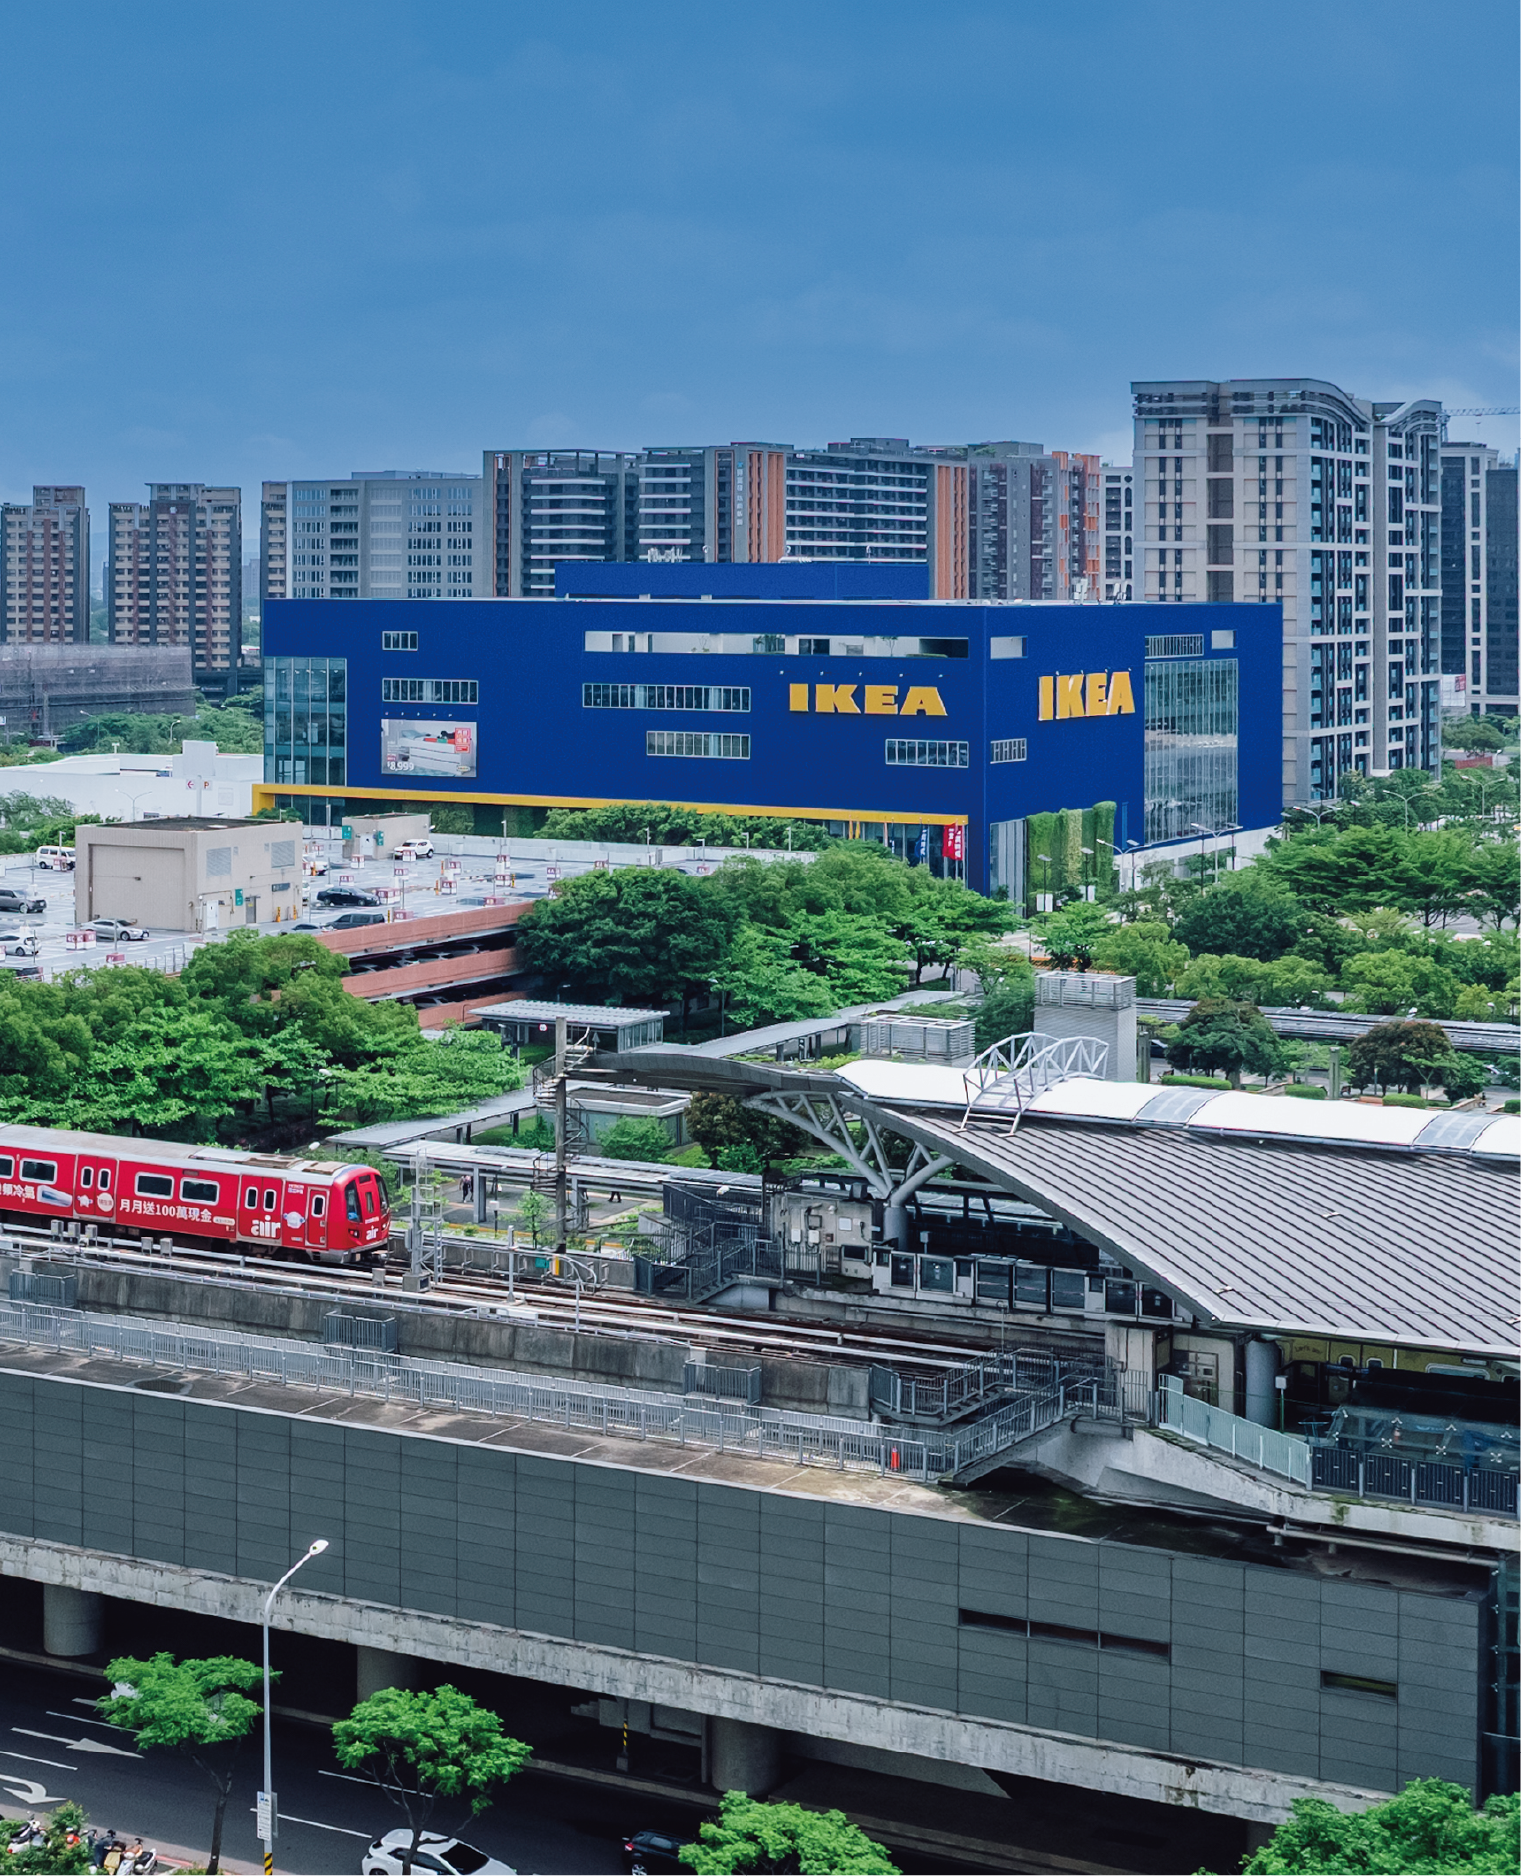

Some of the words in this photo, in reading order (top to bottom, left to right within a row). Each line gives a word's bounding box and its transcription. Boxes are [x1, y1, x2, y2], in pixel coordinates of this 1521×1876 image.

[789, 683, 948, 716] IKEA
[1038, 671, 1136, 721] IKEA
[204, 781, 210, 789] P
[119, 1198, 213, 1224] 月月送100萬現金
[251, 1214, 281, 1238] air
[366, 1225, 379, 1240] air
